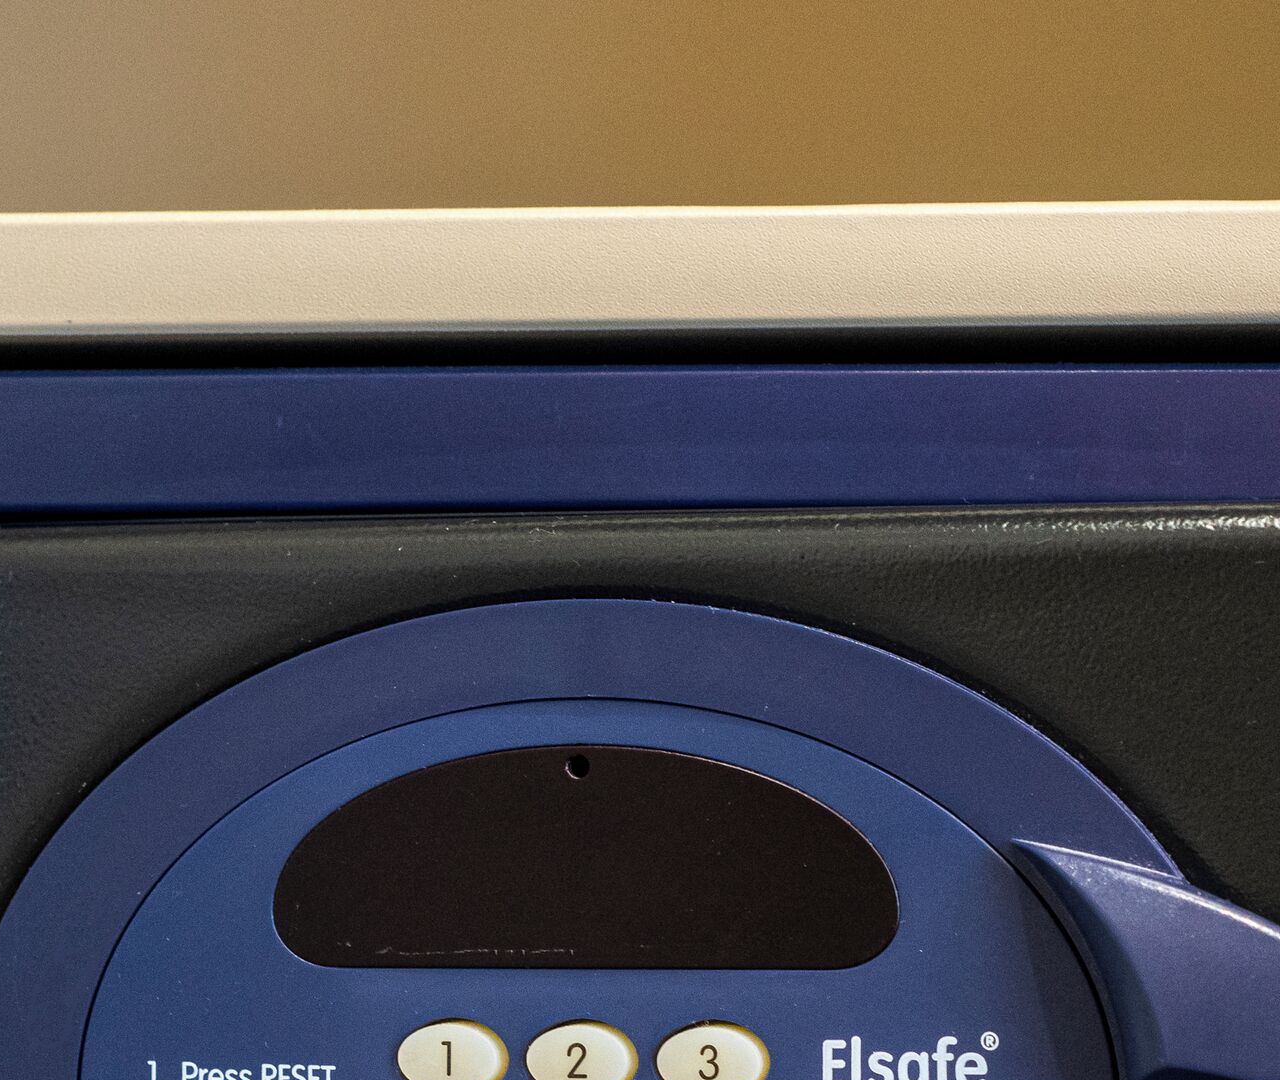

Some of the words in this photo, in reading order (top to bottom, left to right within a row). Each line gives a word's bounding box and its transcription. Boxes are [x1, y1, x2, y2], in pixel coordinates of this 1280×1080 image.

[440, 1040, 453, 1077] 1
[566, 1042, 588, 1079] 2
[698, 1044, 720, 1080] 3
